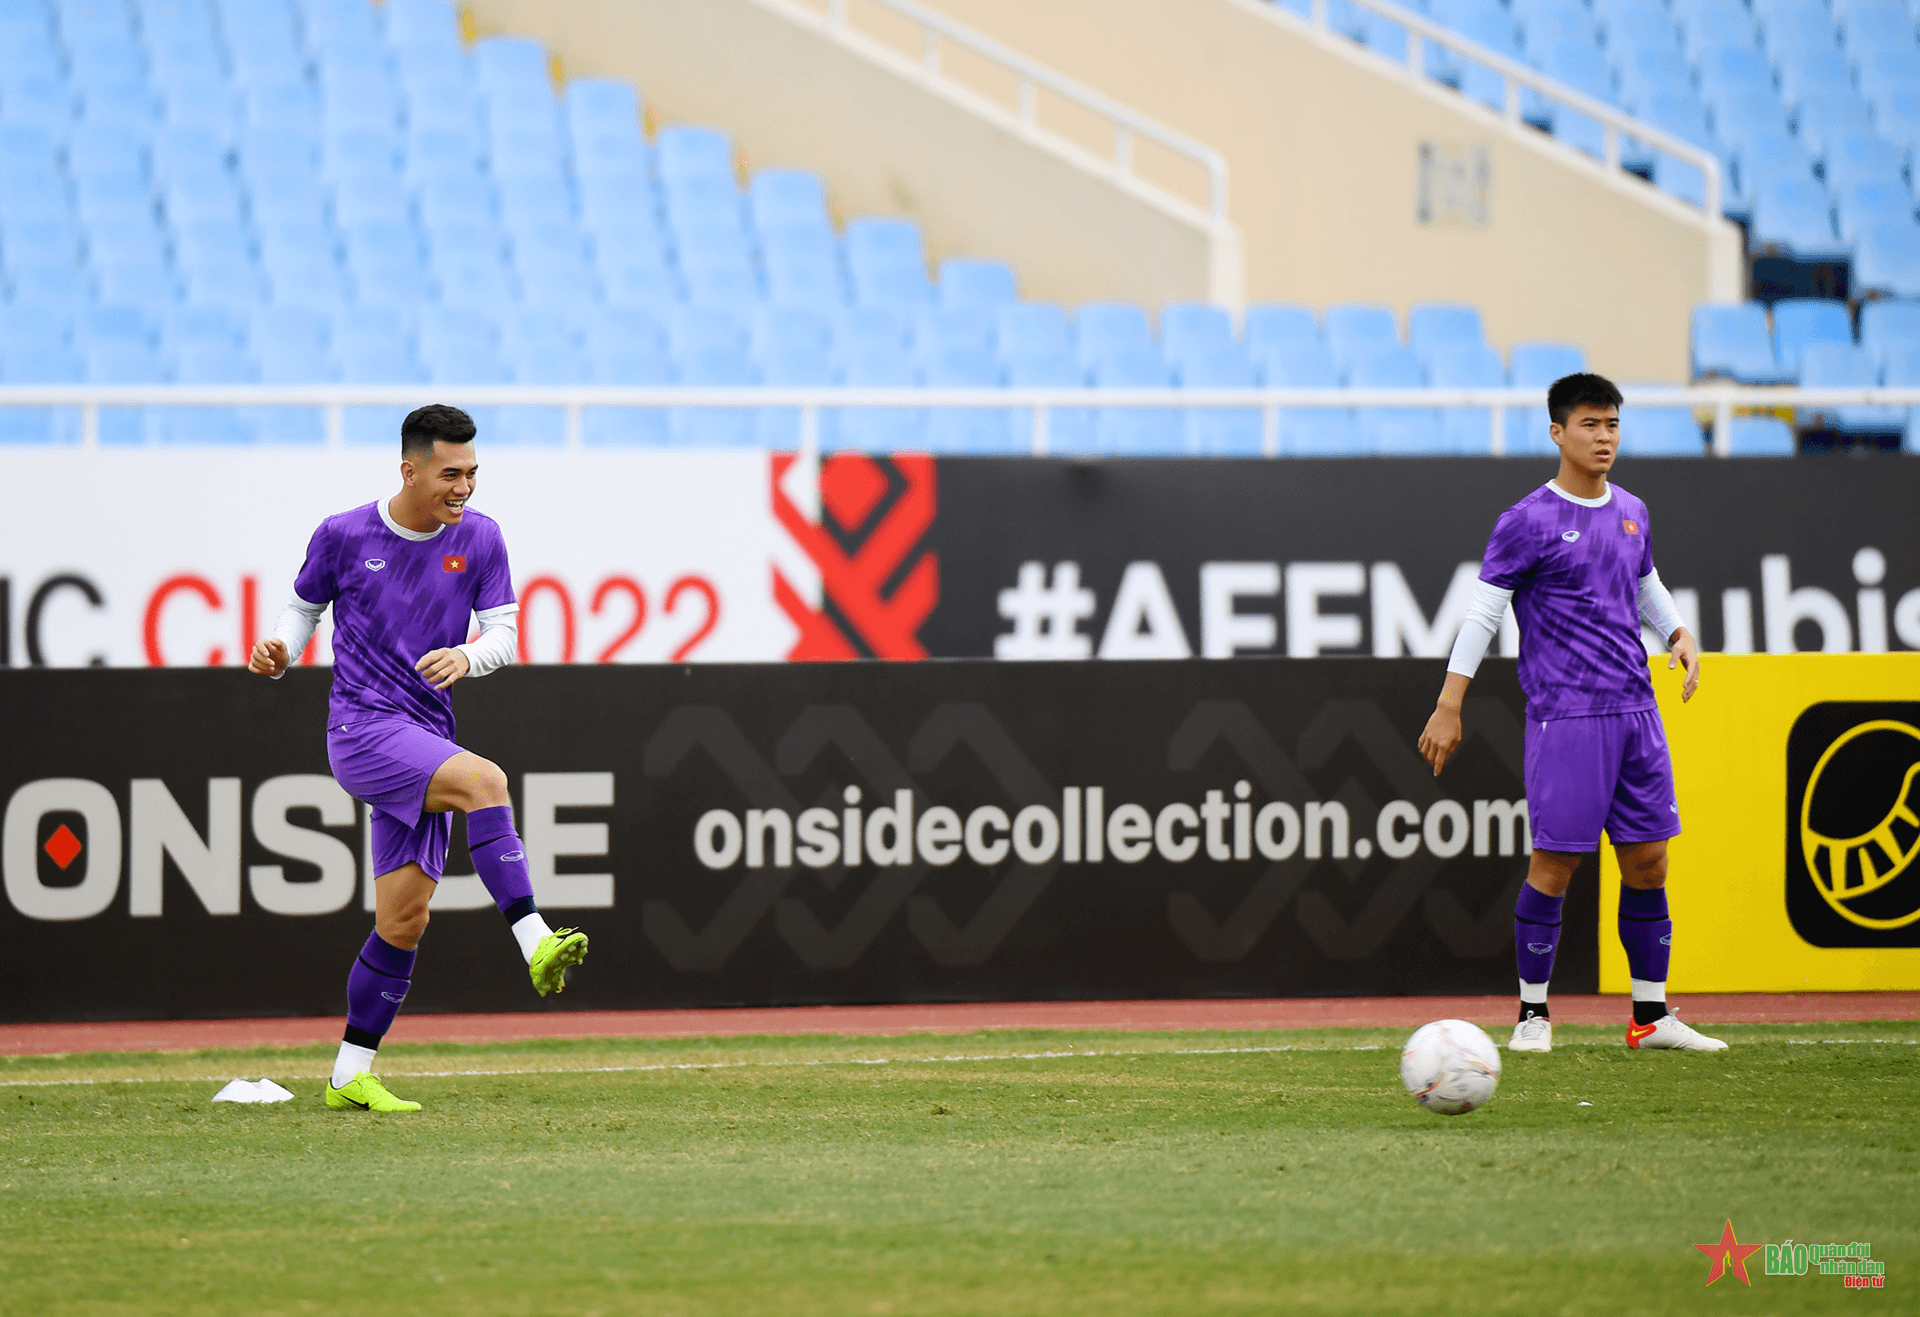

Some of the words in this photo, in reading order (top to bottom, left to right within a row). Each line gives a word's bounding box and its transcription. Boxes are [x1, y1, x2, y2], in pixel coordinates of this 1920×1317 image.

[467, 572, 722, 665] 022
[2, 772, 614, 920] ONSE
[694, 779, 1532, 870] onsidecollection.com
